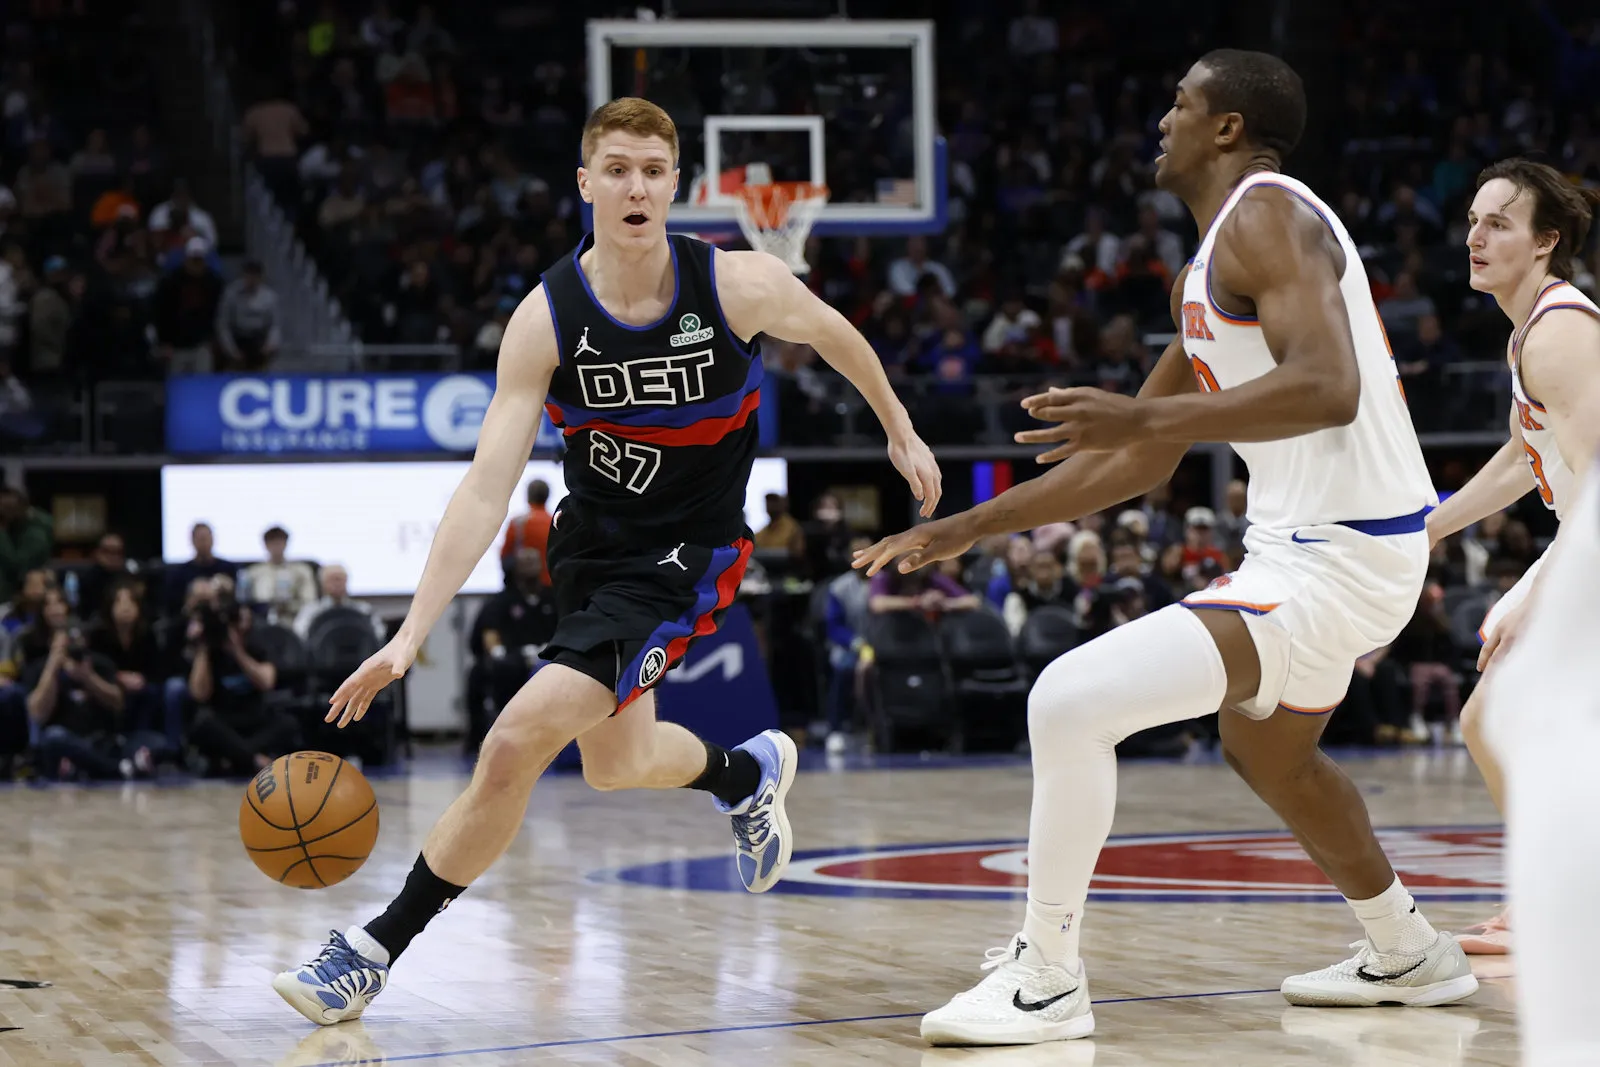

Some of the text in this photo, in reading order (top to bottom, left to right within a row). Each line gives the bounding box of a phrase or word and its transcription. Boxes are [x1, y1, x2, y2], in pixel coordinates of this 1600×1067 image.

[671, 327, 714, 346] StockX
[219, 377, 419, 430] CURE
[577, 348, 715, 409] DET
[221, 430, 369, 450] INSURANCE
[589, 429, 662, 495] 27
